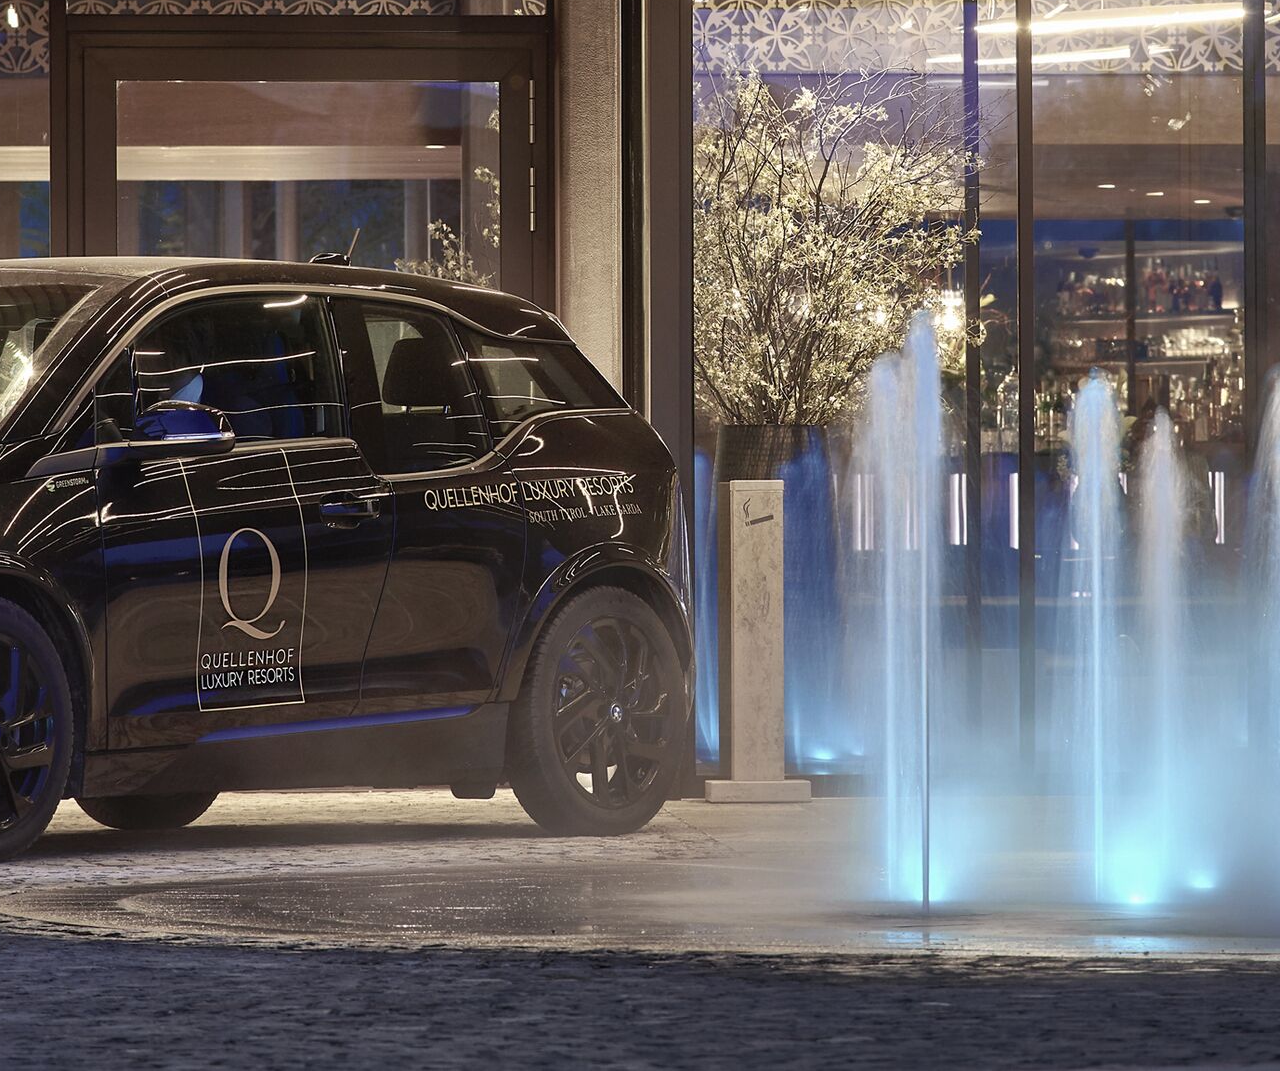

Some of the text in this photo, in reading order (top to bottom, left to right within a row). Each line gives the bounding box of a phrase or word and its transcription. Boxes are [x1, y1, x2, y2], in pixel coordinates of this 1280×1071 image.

[424, 475, 634, 511] QUELLENHOF LUXURY RESORTS
[528, 509, 558, 523] SOUTH
[559, 505, 588, 521] TYROL
[593, 504, 617, 517] LAKE
[219, 527, 286, 640] Q
[200, 648, 295, 670] QUELLENHOF
[200, 666, 295, 690] LUXURY RESORTS
